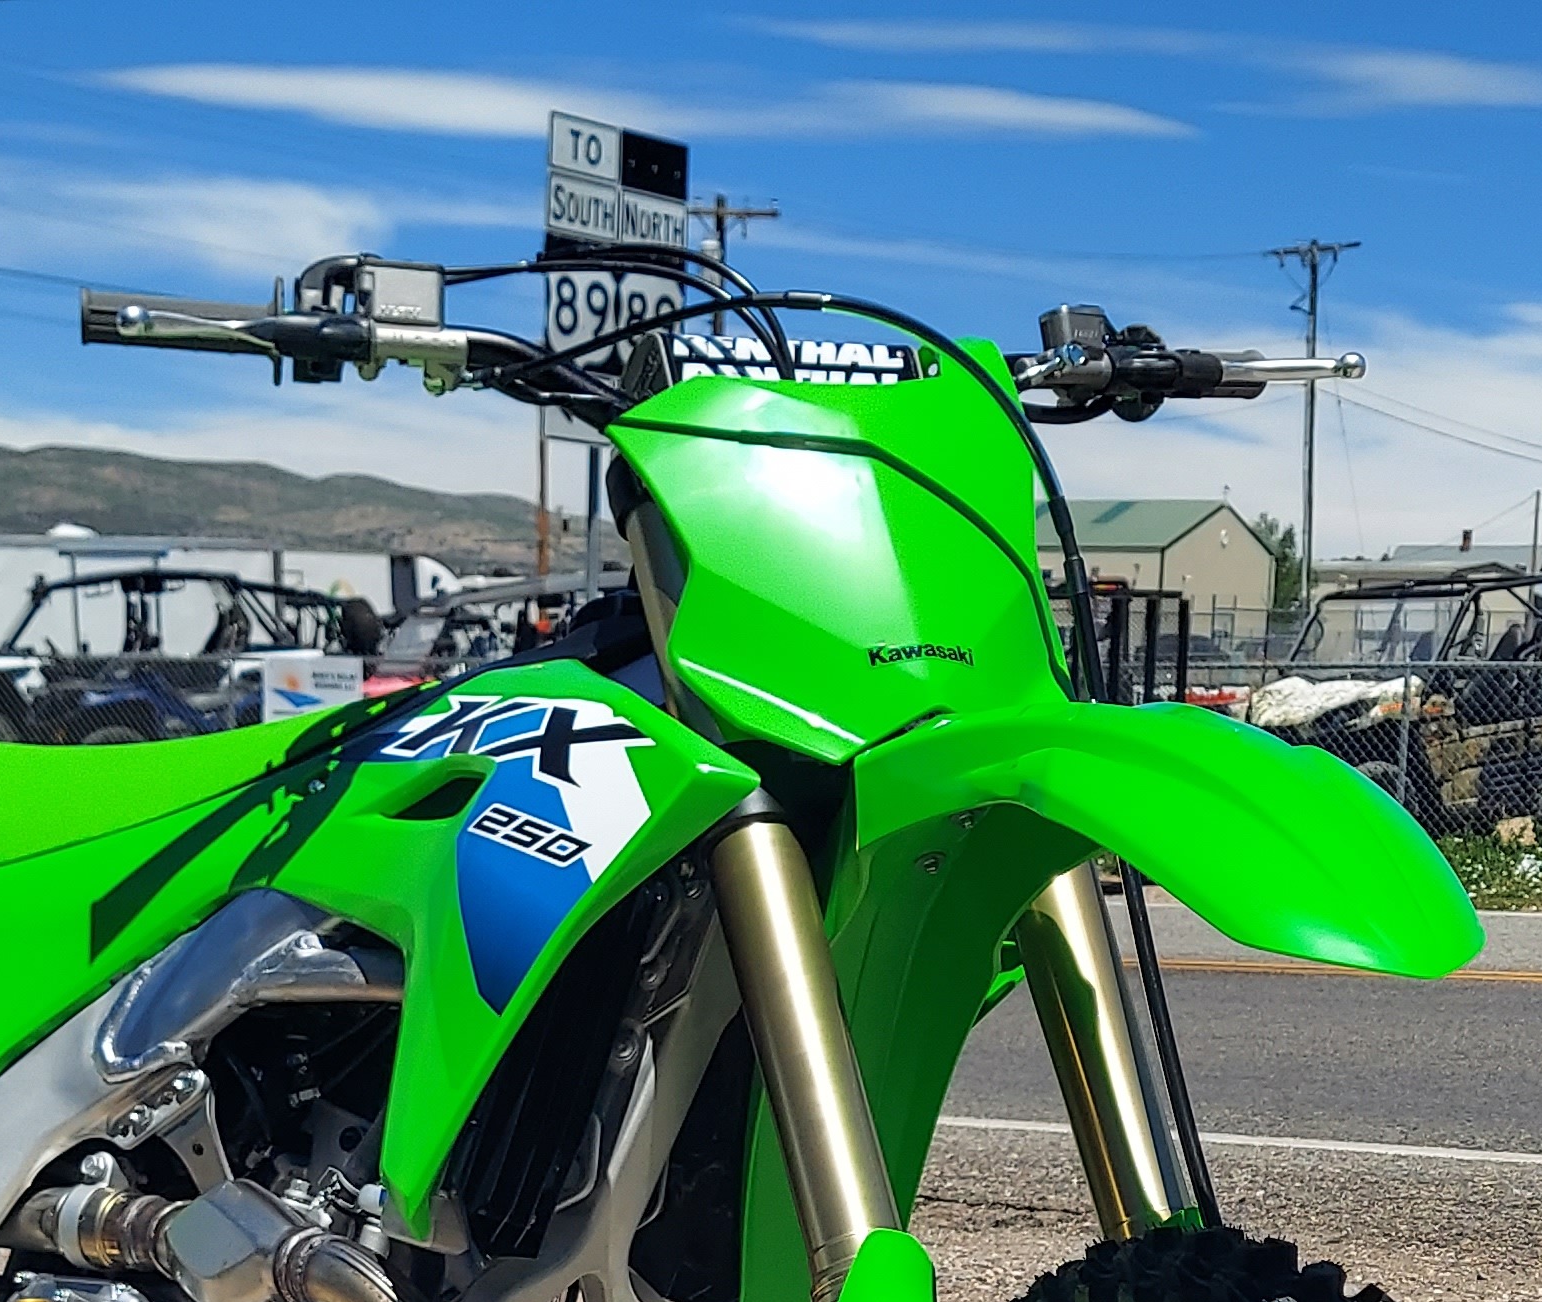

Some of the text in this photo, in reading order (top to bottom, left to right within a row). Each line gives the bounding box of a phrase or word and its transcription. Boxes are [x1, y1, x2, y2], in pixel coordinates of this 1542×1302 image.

[570, 128, 603, 166] TO
[552, 183, 685, 246] SOUTH NORTH
[556, 276, 609, 337] 89
[867, 643, 975, 668] Kawasaki
[380, 695, 656, 789] KX
[468, 803, 593, 868] 250
